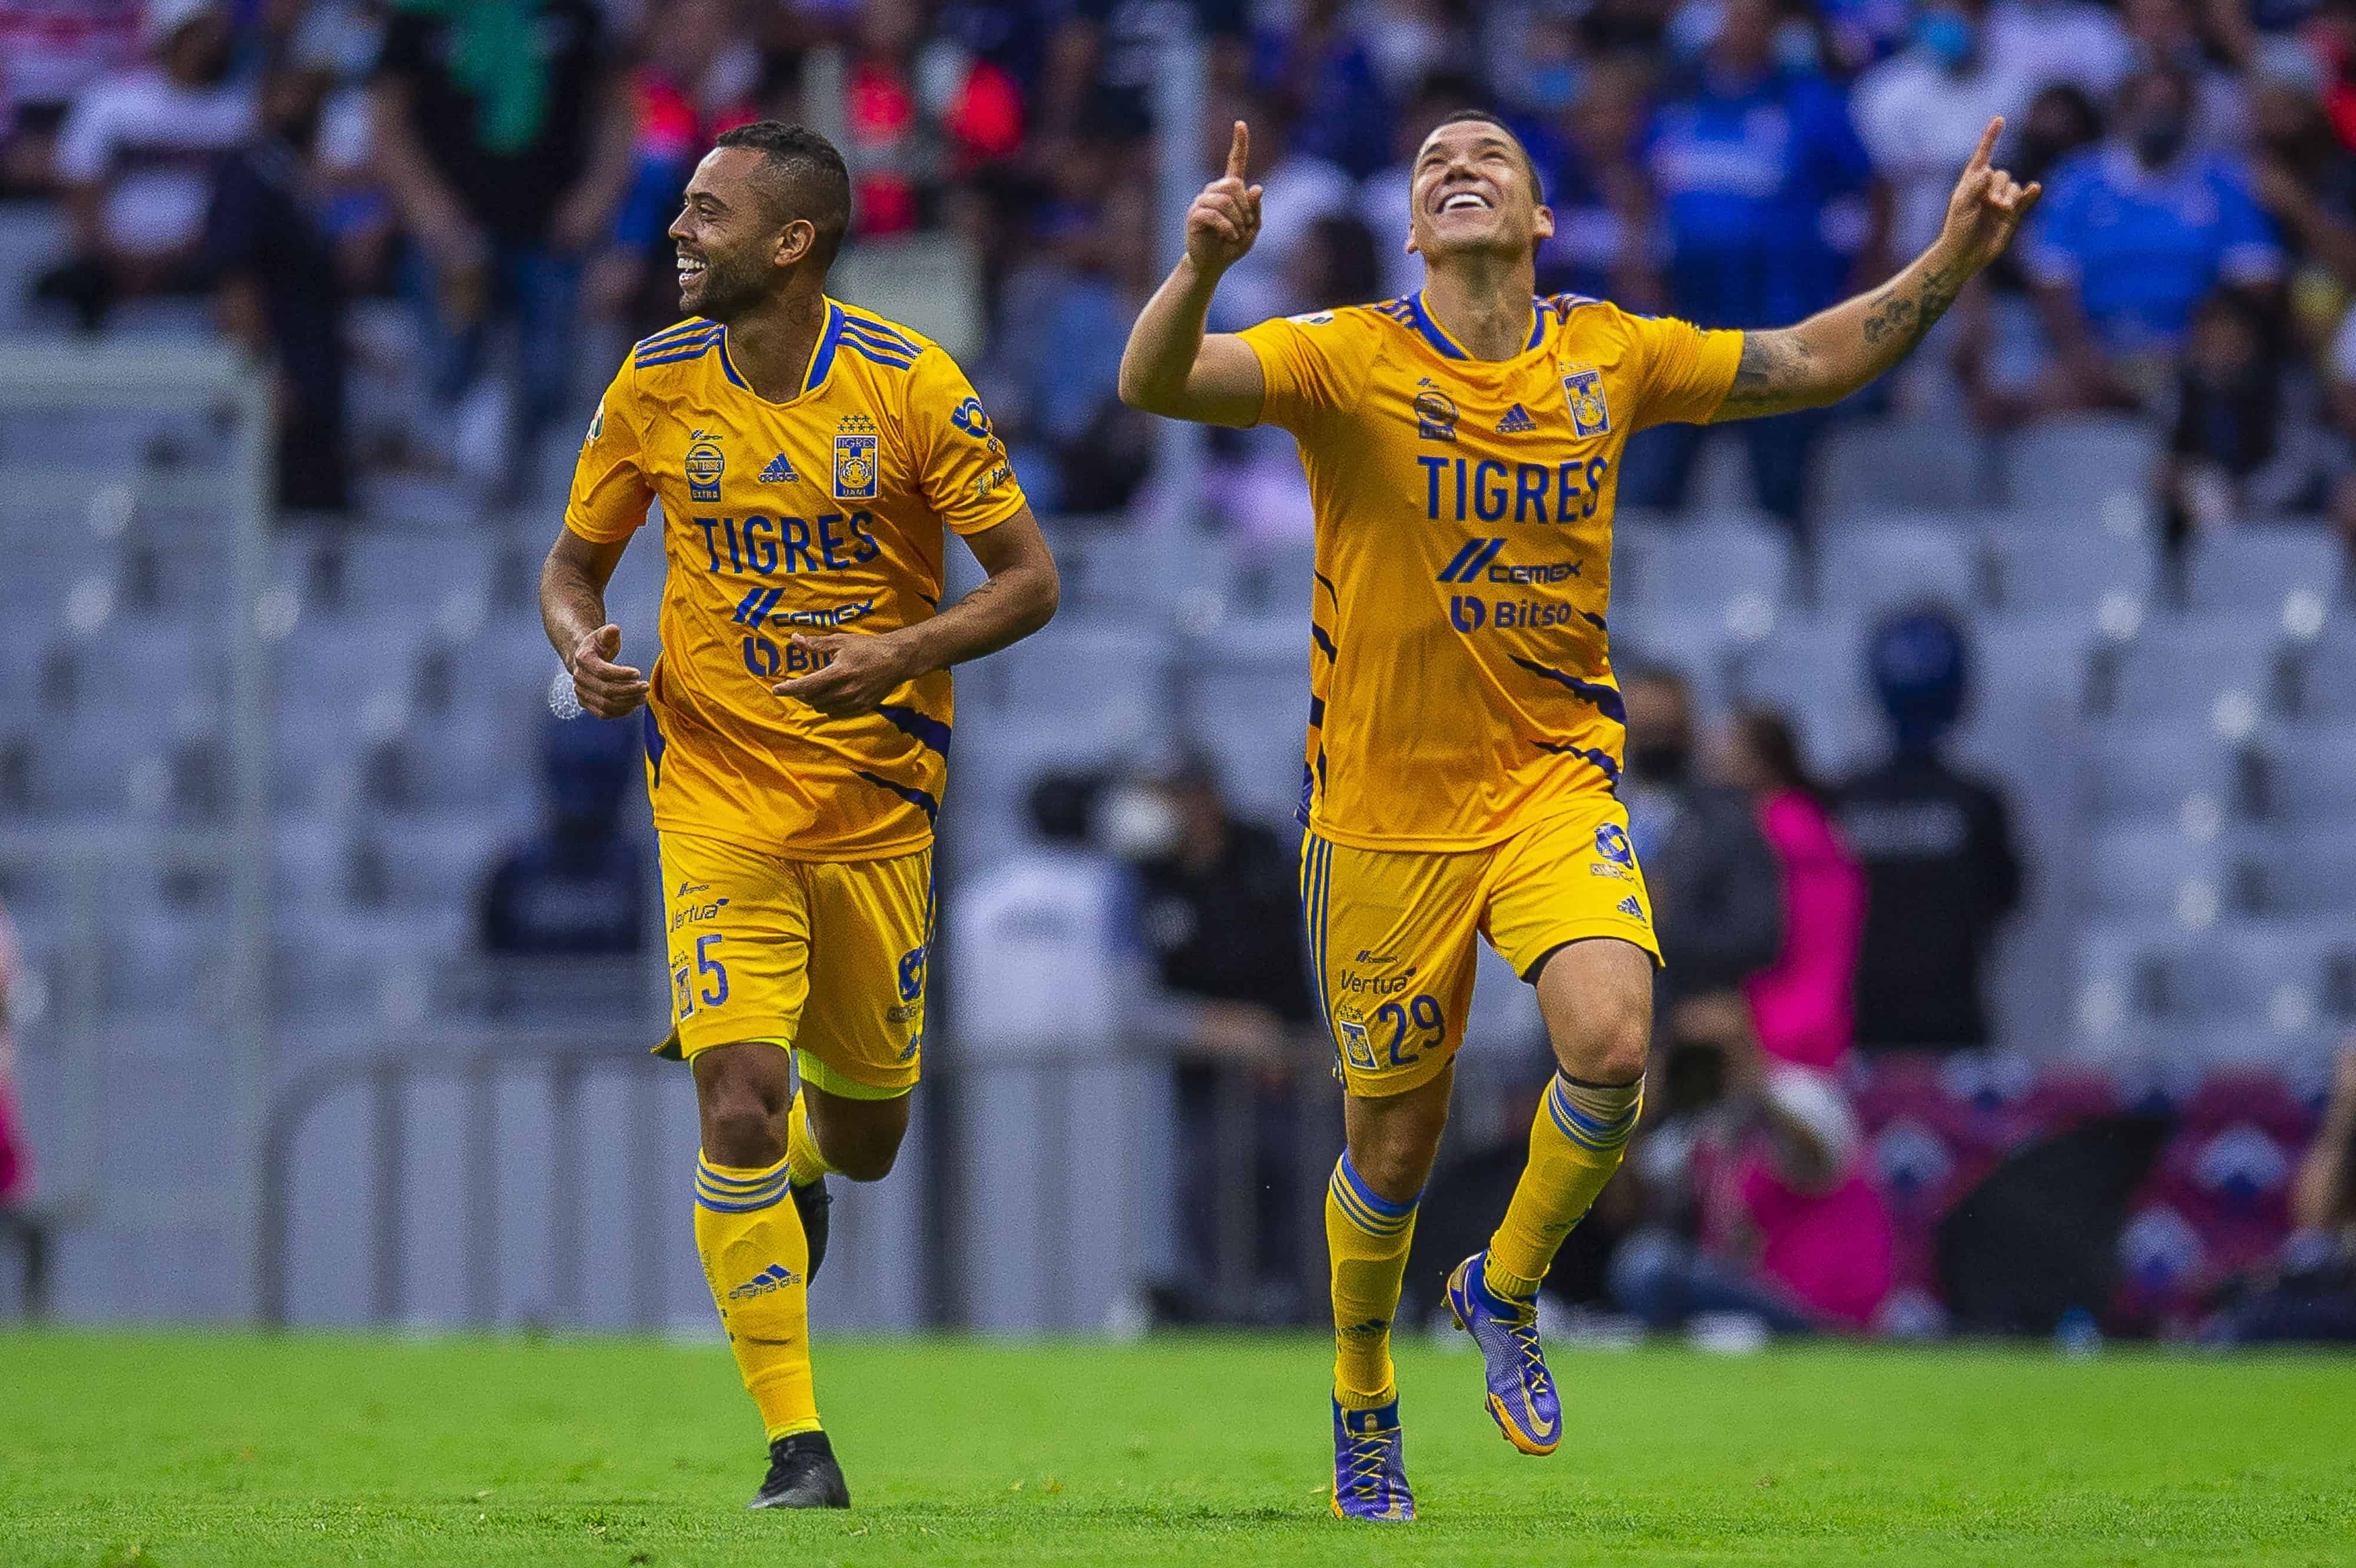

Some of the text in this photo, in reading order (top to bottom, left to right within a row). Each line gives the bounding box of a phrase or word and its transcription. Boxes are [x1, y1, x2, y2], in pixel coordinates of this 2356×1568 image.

[1417, 455, 1607, 524] TIGRES
[693, 511, 881, 574] TIGRES
[1494, 598, 1571, 628] Bitso
[696, 934, 729, 1007] 5
[1341, 969, 1408, 994] Vertua
[1378, 994, 1446, 1066] 29
